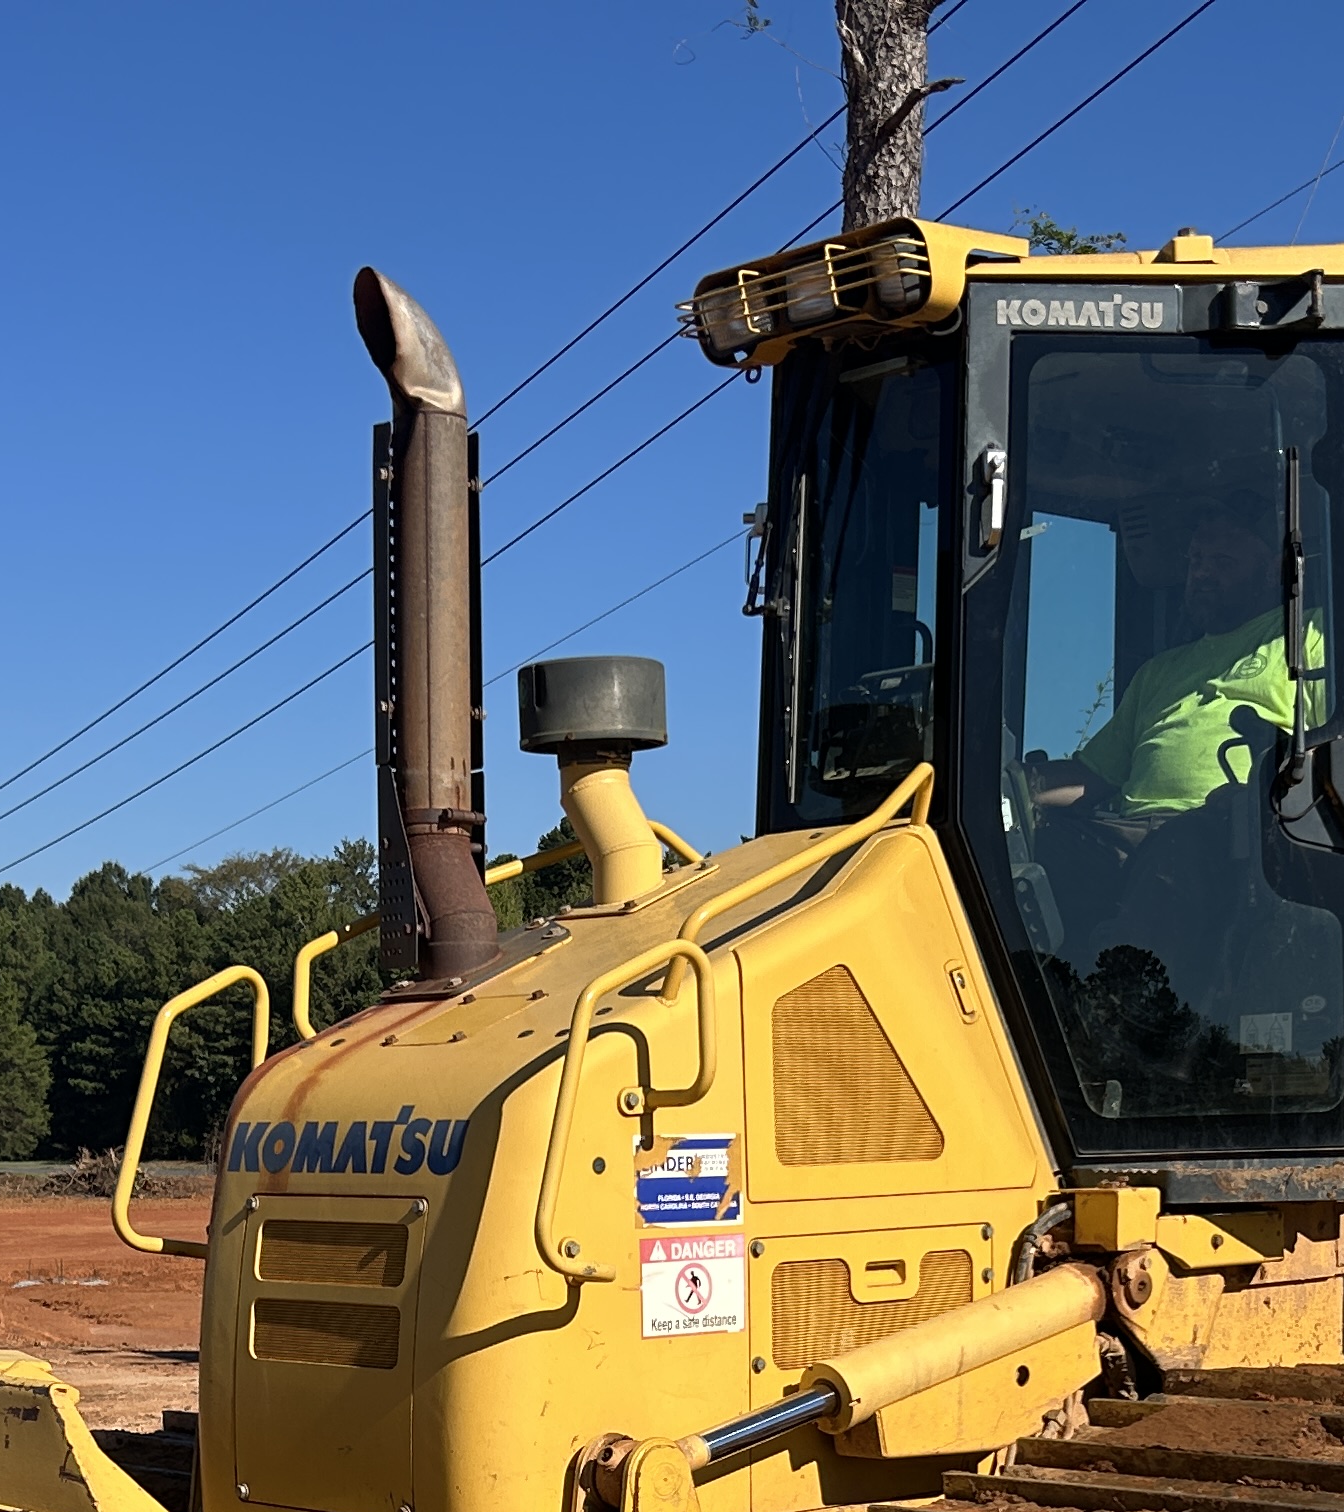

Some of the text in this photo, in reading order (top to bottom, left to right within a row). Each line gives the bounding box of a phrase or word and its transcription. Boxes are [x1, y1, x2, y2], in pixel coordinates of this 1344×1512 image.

[996, 294, 1164, 329] KOMATSU
[227, 1105, 471, 1176] KOMATSU
[670, 1240, 737, 1260] DANGER
[651, 1318, 673, 1332] Keep
[674, 1320, 680, 1330] a
[702, 1314, 737, 1327] distance
